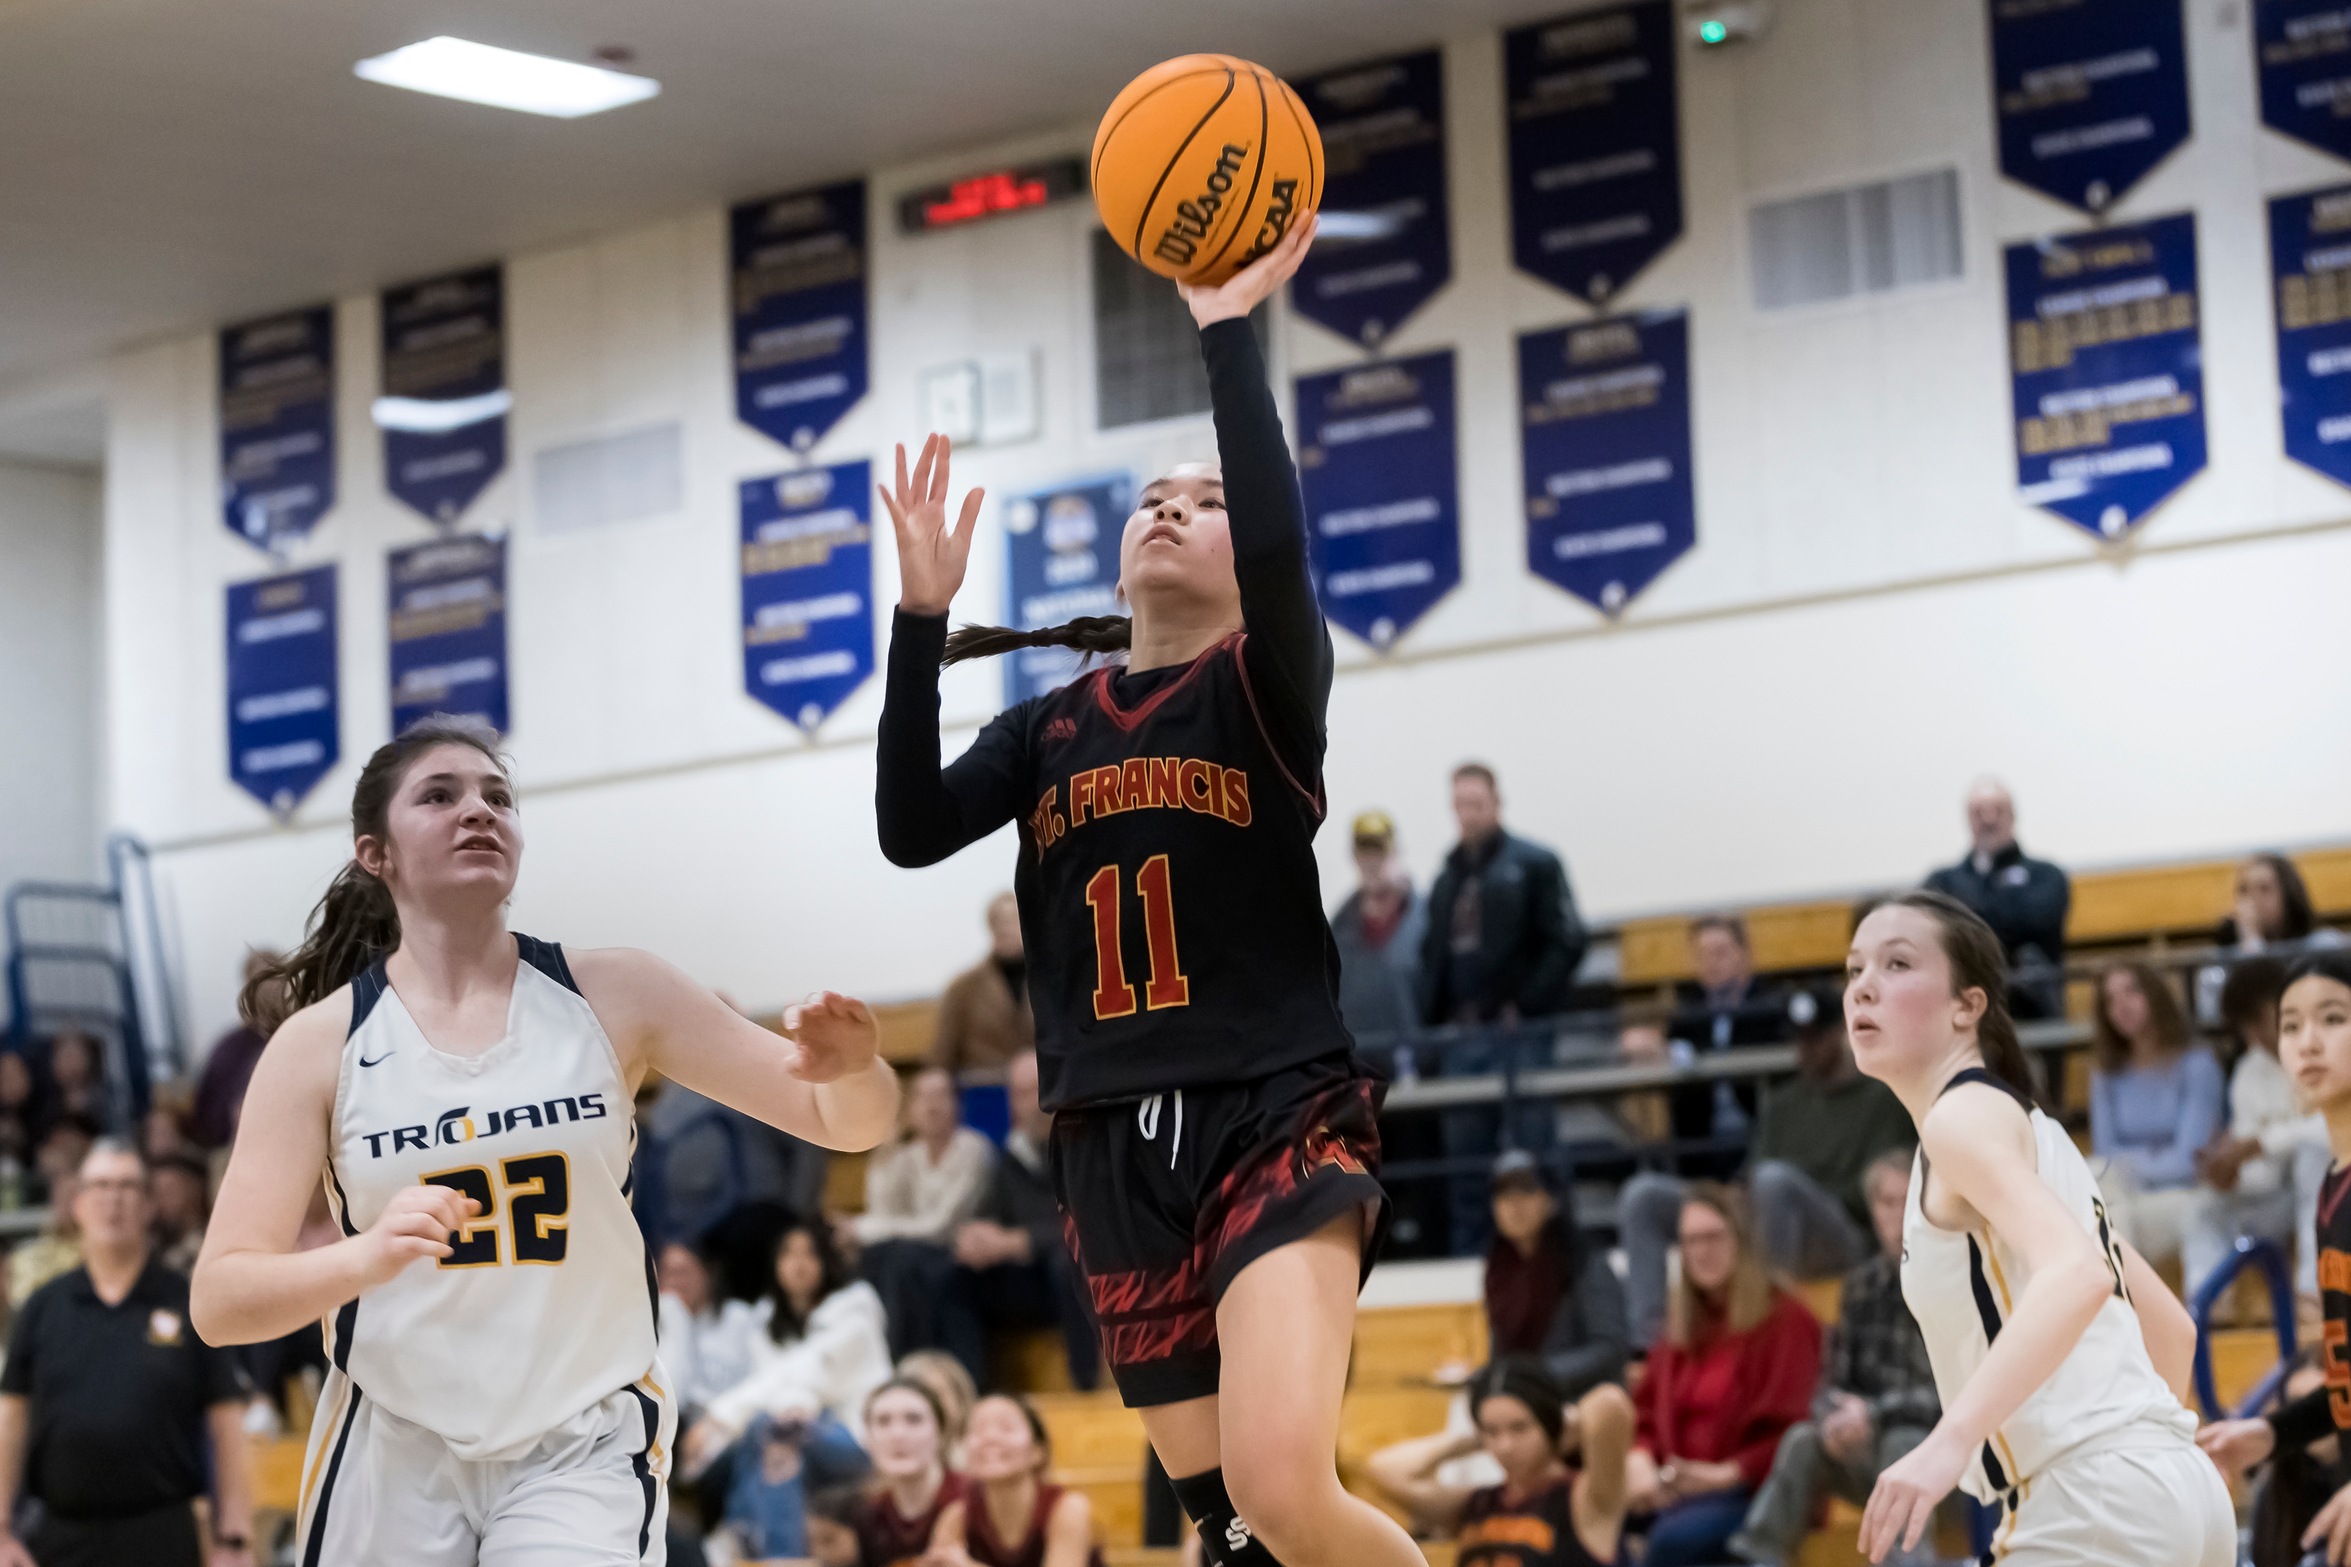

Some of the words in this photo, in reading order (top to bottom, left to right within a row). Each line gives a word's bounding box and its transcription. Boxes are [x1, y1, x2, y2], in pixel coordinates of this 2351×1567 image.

[1153, 143, 1248, 266] Wilson
[1070, 757, 1252, 828] FRANCIS
[1086, 854, 1189, 1021] 11
[362, 1094, 607, 1158] TROJANS
[418, 1150, 570, 1270] 22
